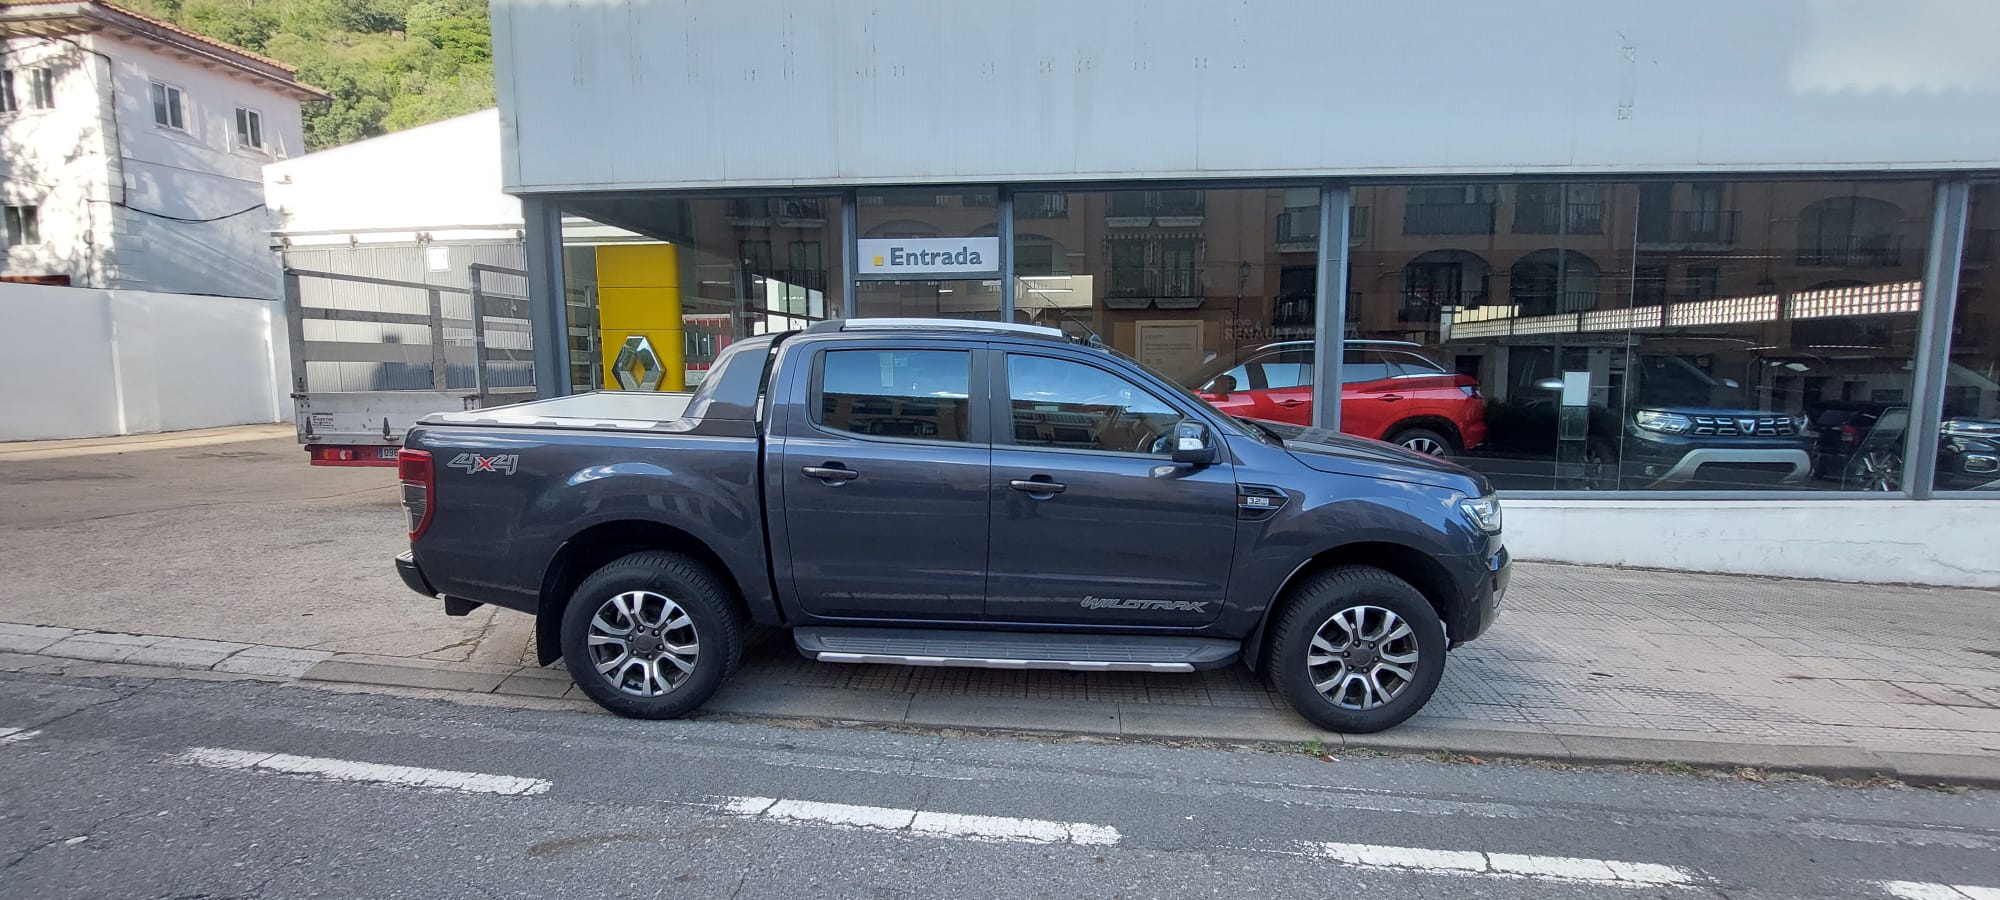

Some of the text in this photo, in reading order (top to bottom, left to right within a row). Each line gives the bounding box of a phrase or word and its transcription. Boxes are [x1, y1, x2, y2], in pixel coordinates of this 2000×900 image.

[890, 246, 983, 266] Entrada
[1224, 327, 1293, 340] RENAULT
[1080, 596, 1209, 613] WILDTRAK
